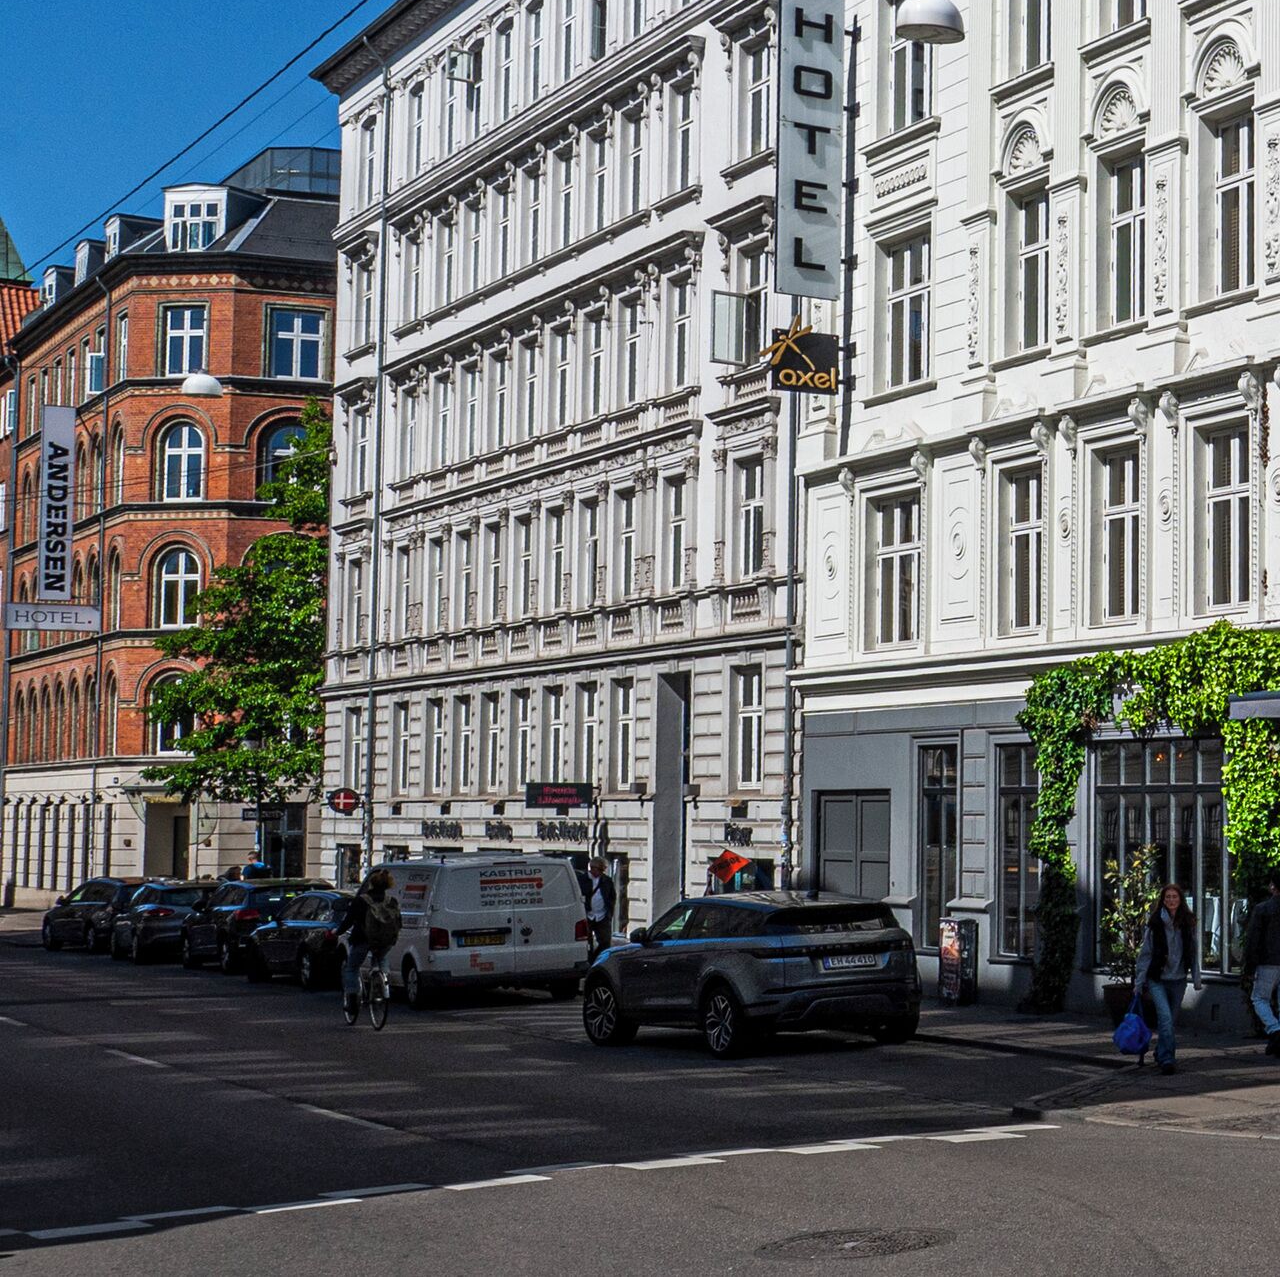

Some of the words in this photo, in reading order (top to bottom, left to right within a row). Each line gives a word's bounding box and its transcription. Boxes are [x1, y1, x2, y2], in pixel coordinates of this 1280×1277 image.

[793, 7, 834, 271] HOTEL
[779, 367, 836, 389] axel
[44, 441, 70, 592] ANDERSEN
[480, 868, 542, 878] KASTRUP
[480, 883, 535, 891] BYGNINGS
